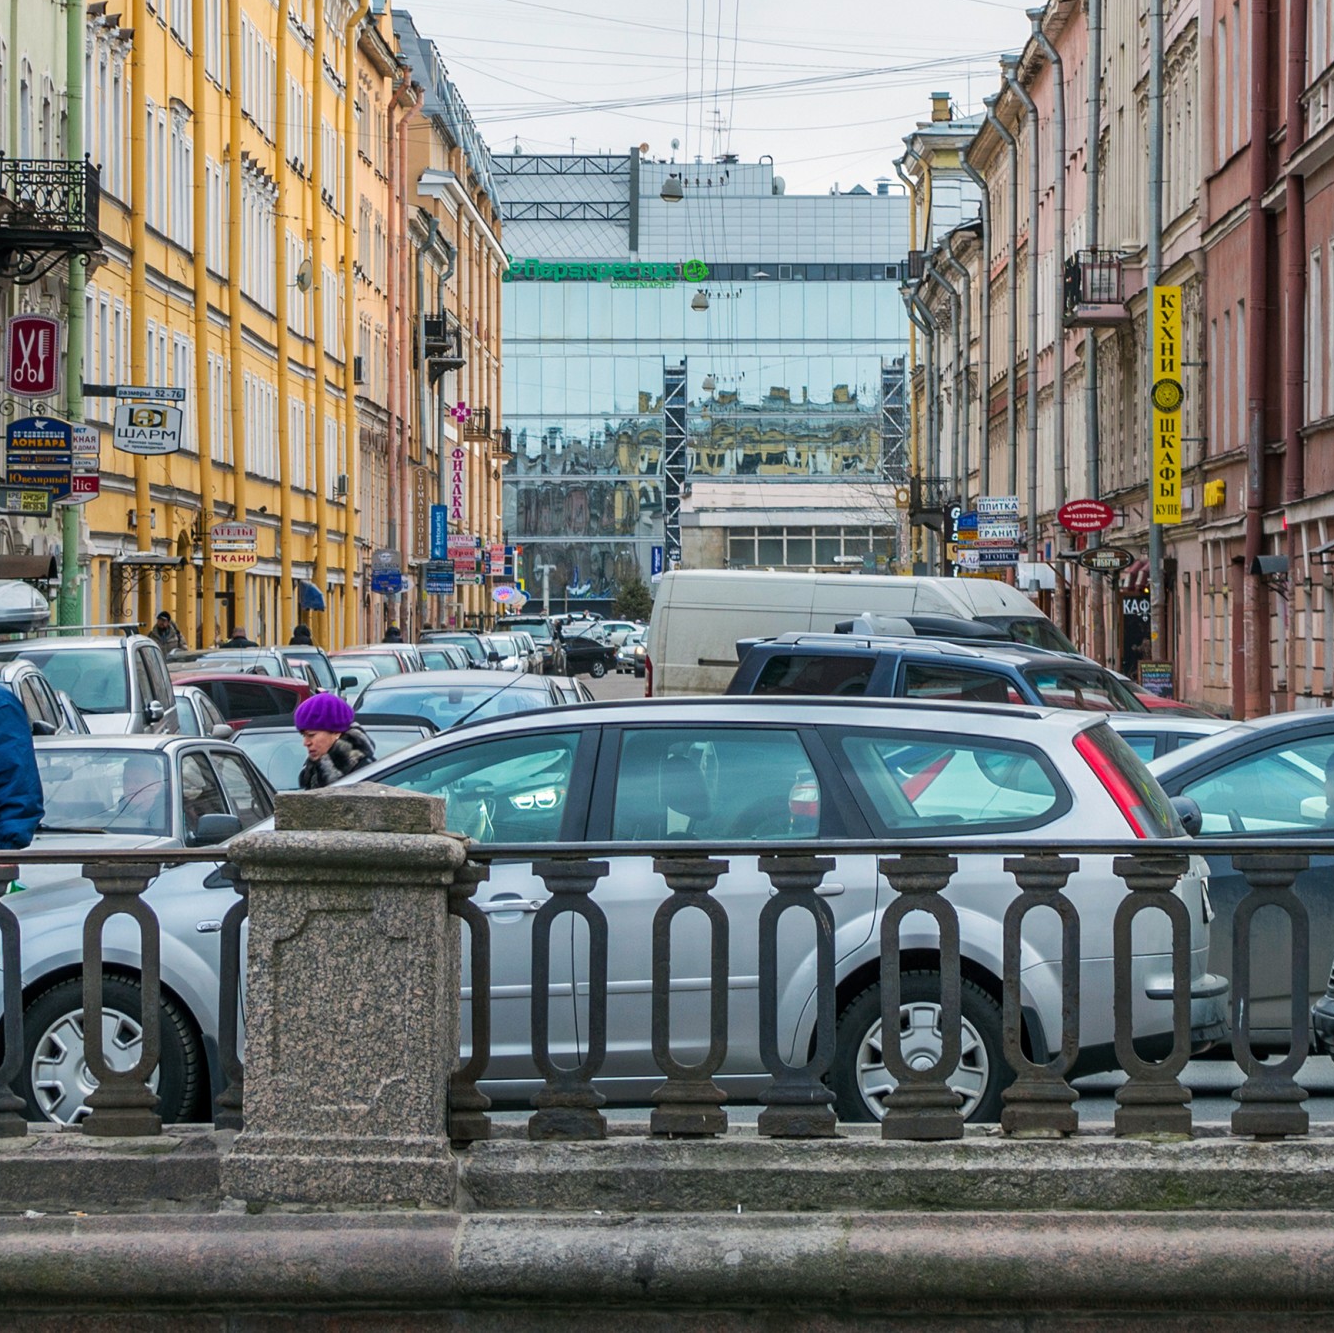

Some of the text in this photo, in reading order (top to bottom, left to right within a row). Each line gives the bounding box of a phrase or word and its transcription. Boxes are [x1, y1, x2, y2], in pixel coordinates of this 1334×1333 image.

[524, 259, 677, 282] Перекресток
[1160, 294, 1175, 372] КУХНИ
[155, 389, 165, 397] 52
[171, 390, 182, 398] 76
[455, 408, 468, 418] 24
[118, 428, 176, 441] ШАРМ
[12, 438, 66, 447] ЛОМБАРД
[1160, 419, 1175, 497] ШКАФЫ
[9, 473, 69, 485] Ювелирный
[451, 448, 465, 520] ФИАЛКА
[416, 470, 425, 555] СТОМАТОЛОГИЯ
[978, 503, 1018, 511] ПЛИТКА
[1155, 504, 1180, 515] КУПЕ
[978, 530, 1019, 538] ГРАНИТ
